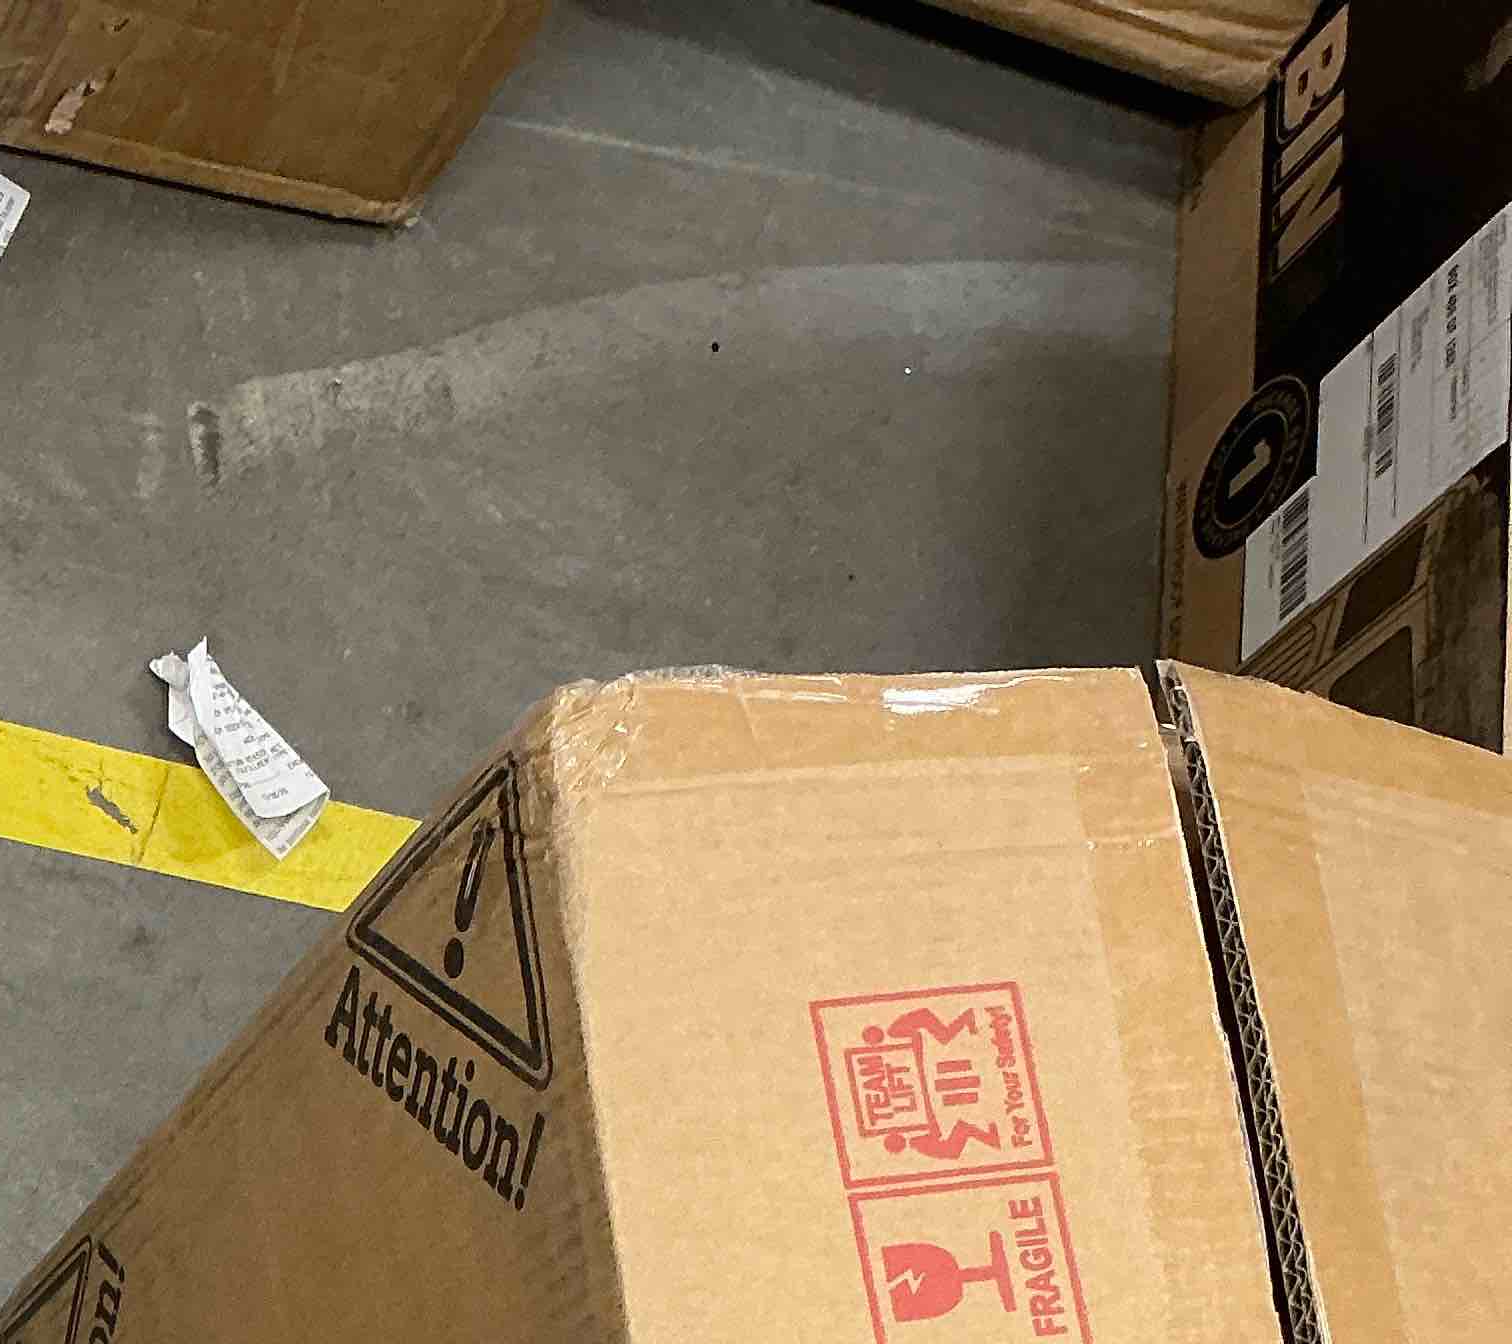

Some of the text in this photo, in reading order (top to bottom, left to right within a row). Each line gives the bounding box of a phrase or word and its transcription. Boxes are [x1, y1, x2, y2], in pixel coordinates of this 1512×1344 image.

[325, 967, 545, 1210] Attention!
[858, 1055, 893, 1126] TEAM
[885, 1064, 917, 1113] LIFT
[1008, 1197, 1068, 1336] FRAGILE
